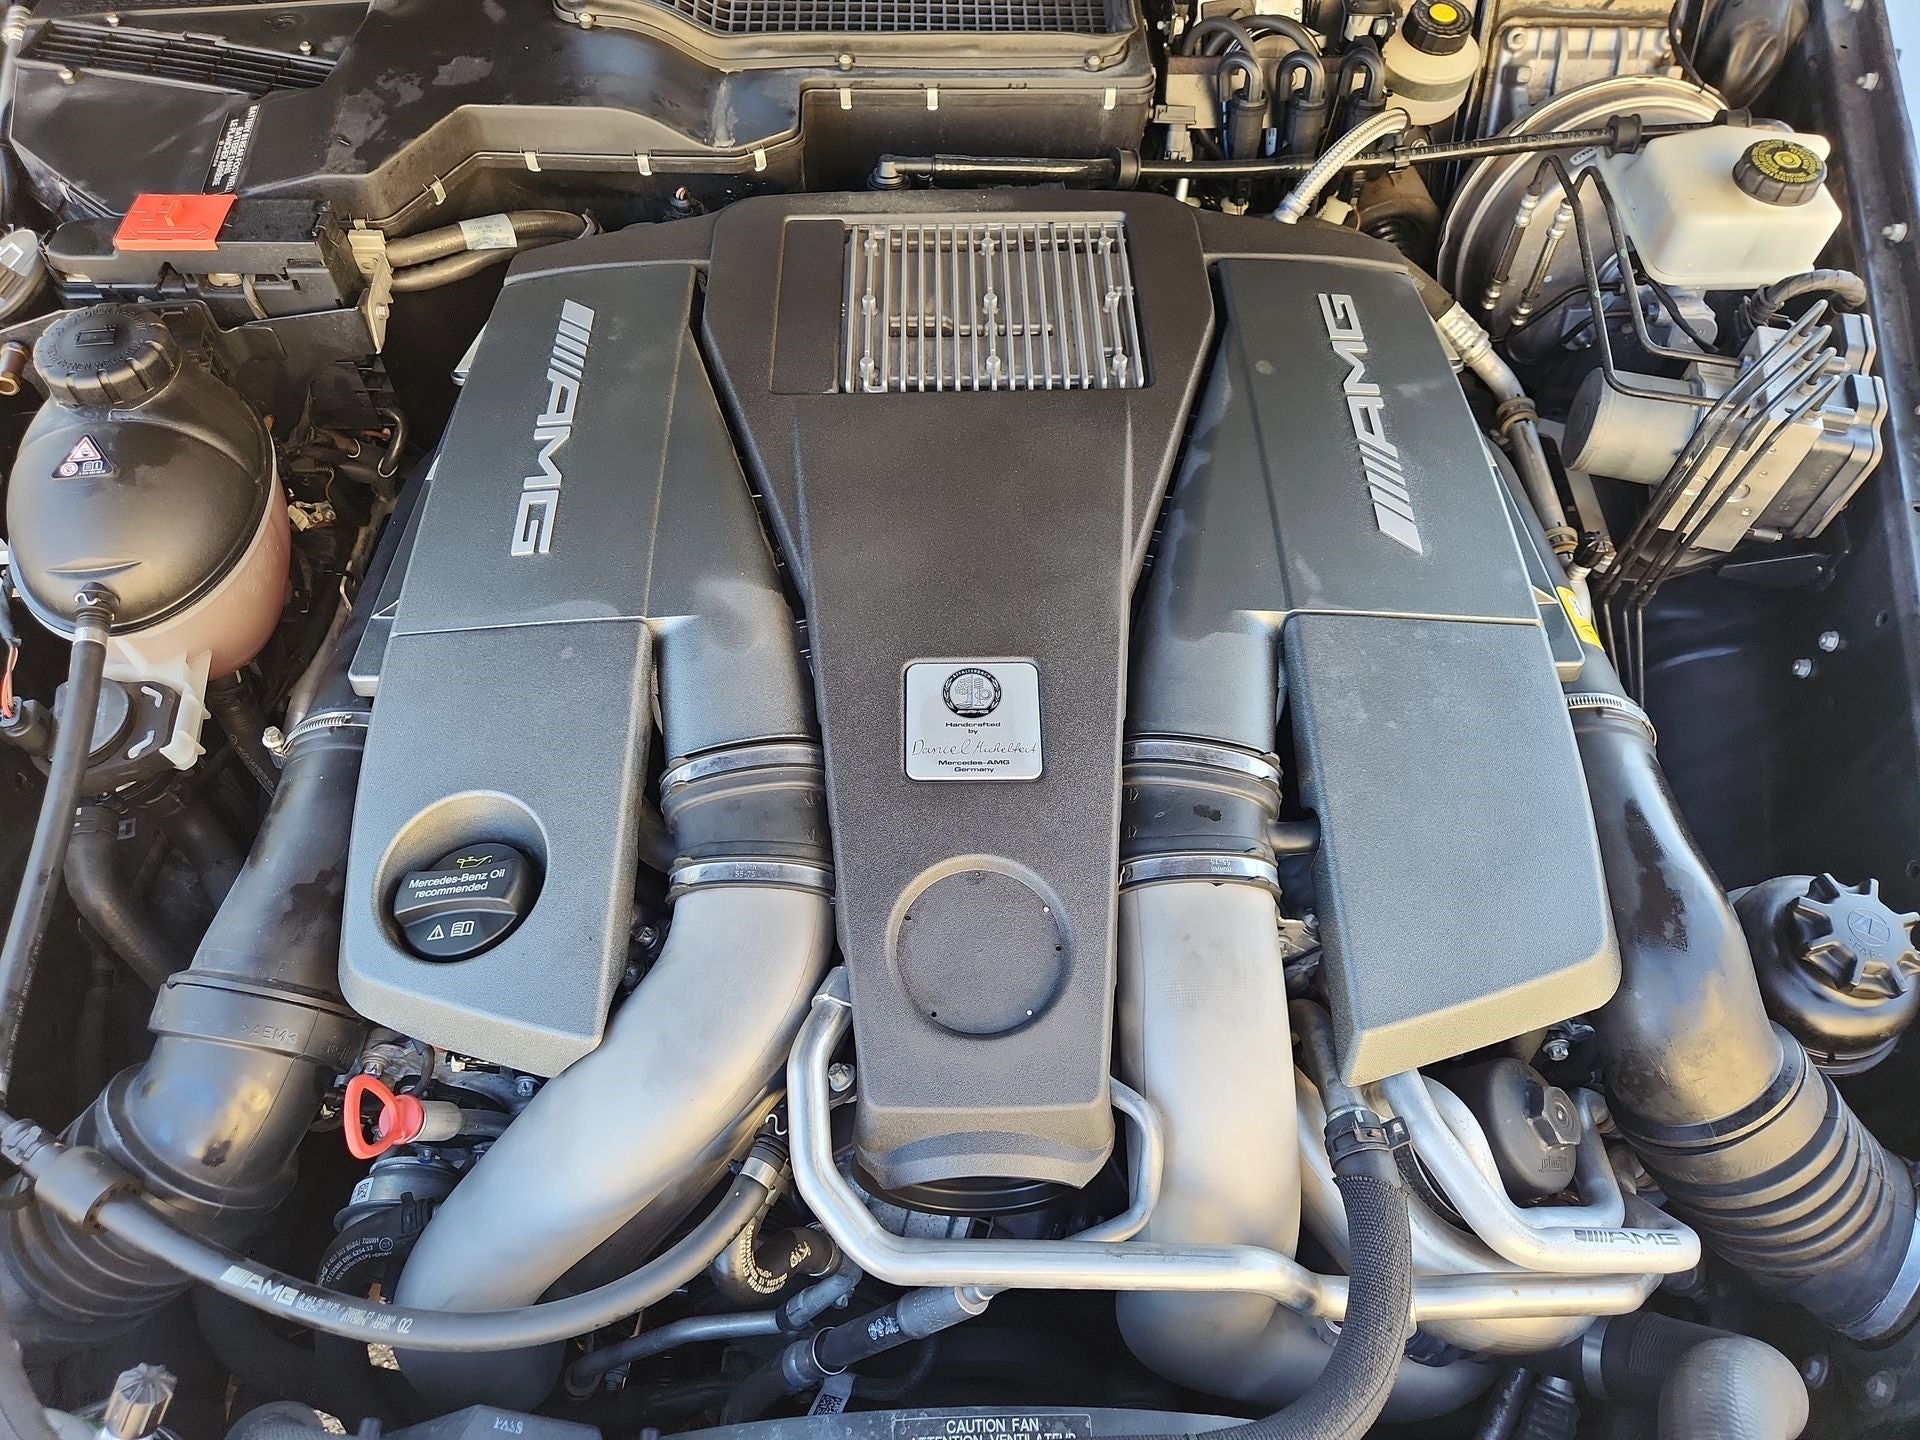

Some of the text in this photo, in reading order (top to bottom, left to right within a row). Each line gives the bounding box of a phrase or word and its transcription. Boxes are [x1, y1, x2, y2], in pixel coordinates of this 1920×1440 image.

[229, 119, 239, 128] LE
[243, 105, 259, 133] BATTERY
[219, 127, 237, 161] PLANCHER
[224, 127, 244, 174] BATTERIE DANS
[235, 141, 248, 158] REAR
[225, 158, 243, 192] FOOTWELL
[1317, 292, 1401, 462] AMG
[511, 367, 580, 557] AMG
[912, 738, 971, 756] Daniel
[408, 868, 506, 889] Mercedes-Benz Oil
[735, 870, 756, 878] 55-75
[414, 881, 489, 899] recommended
[1608, 1230, 1682, 1246] AMG
[242, 1272, 300, 1307] AMG
[396, 1317, 414, 1334] 02
[946, 1417, 1040, 1434] CAUTION FAN
